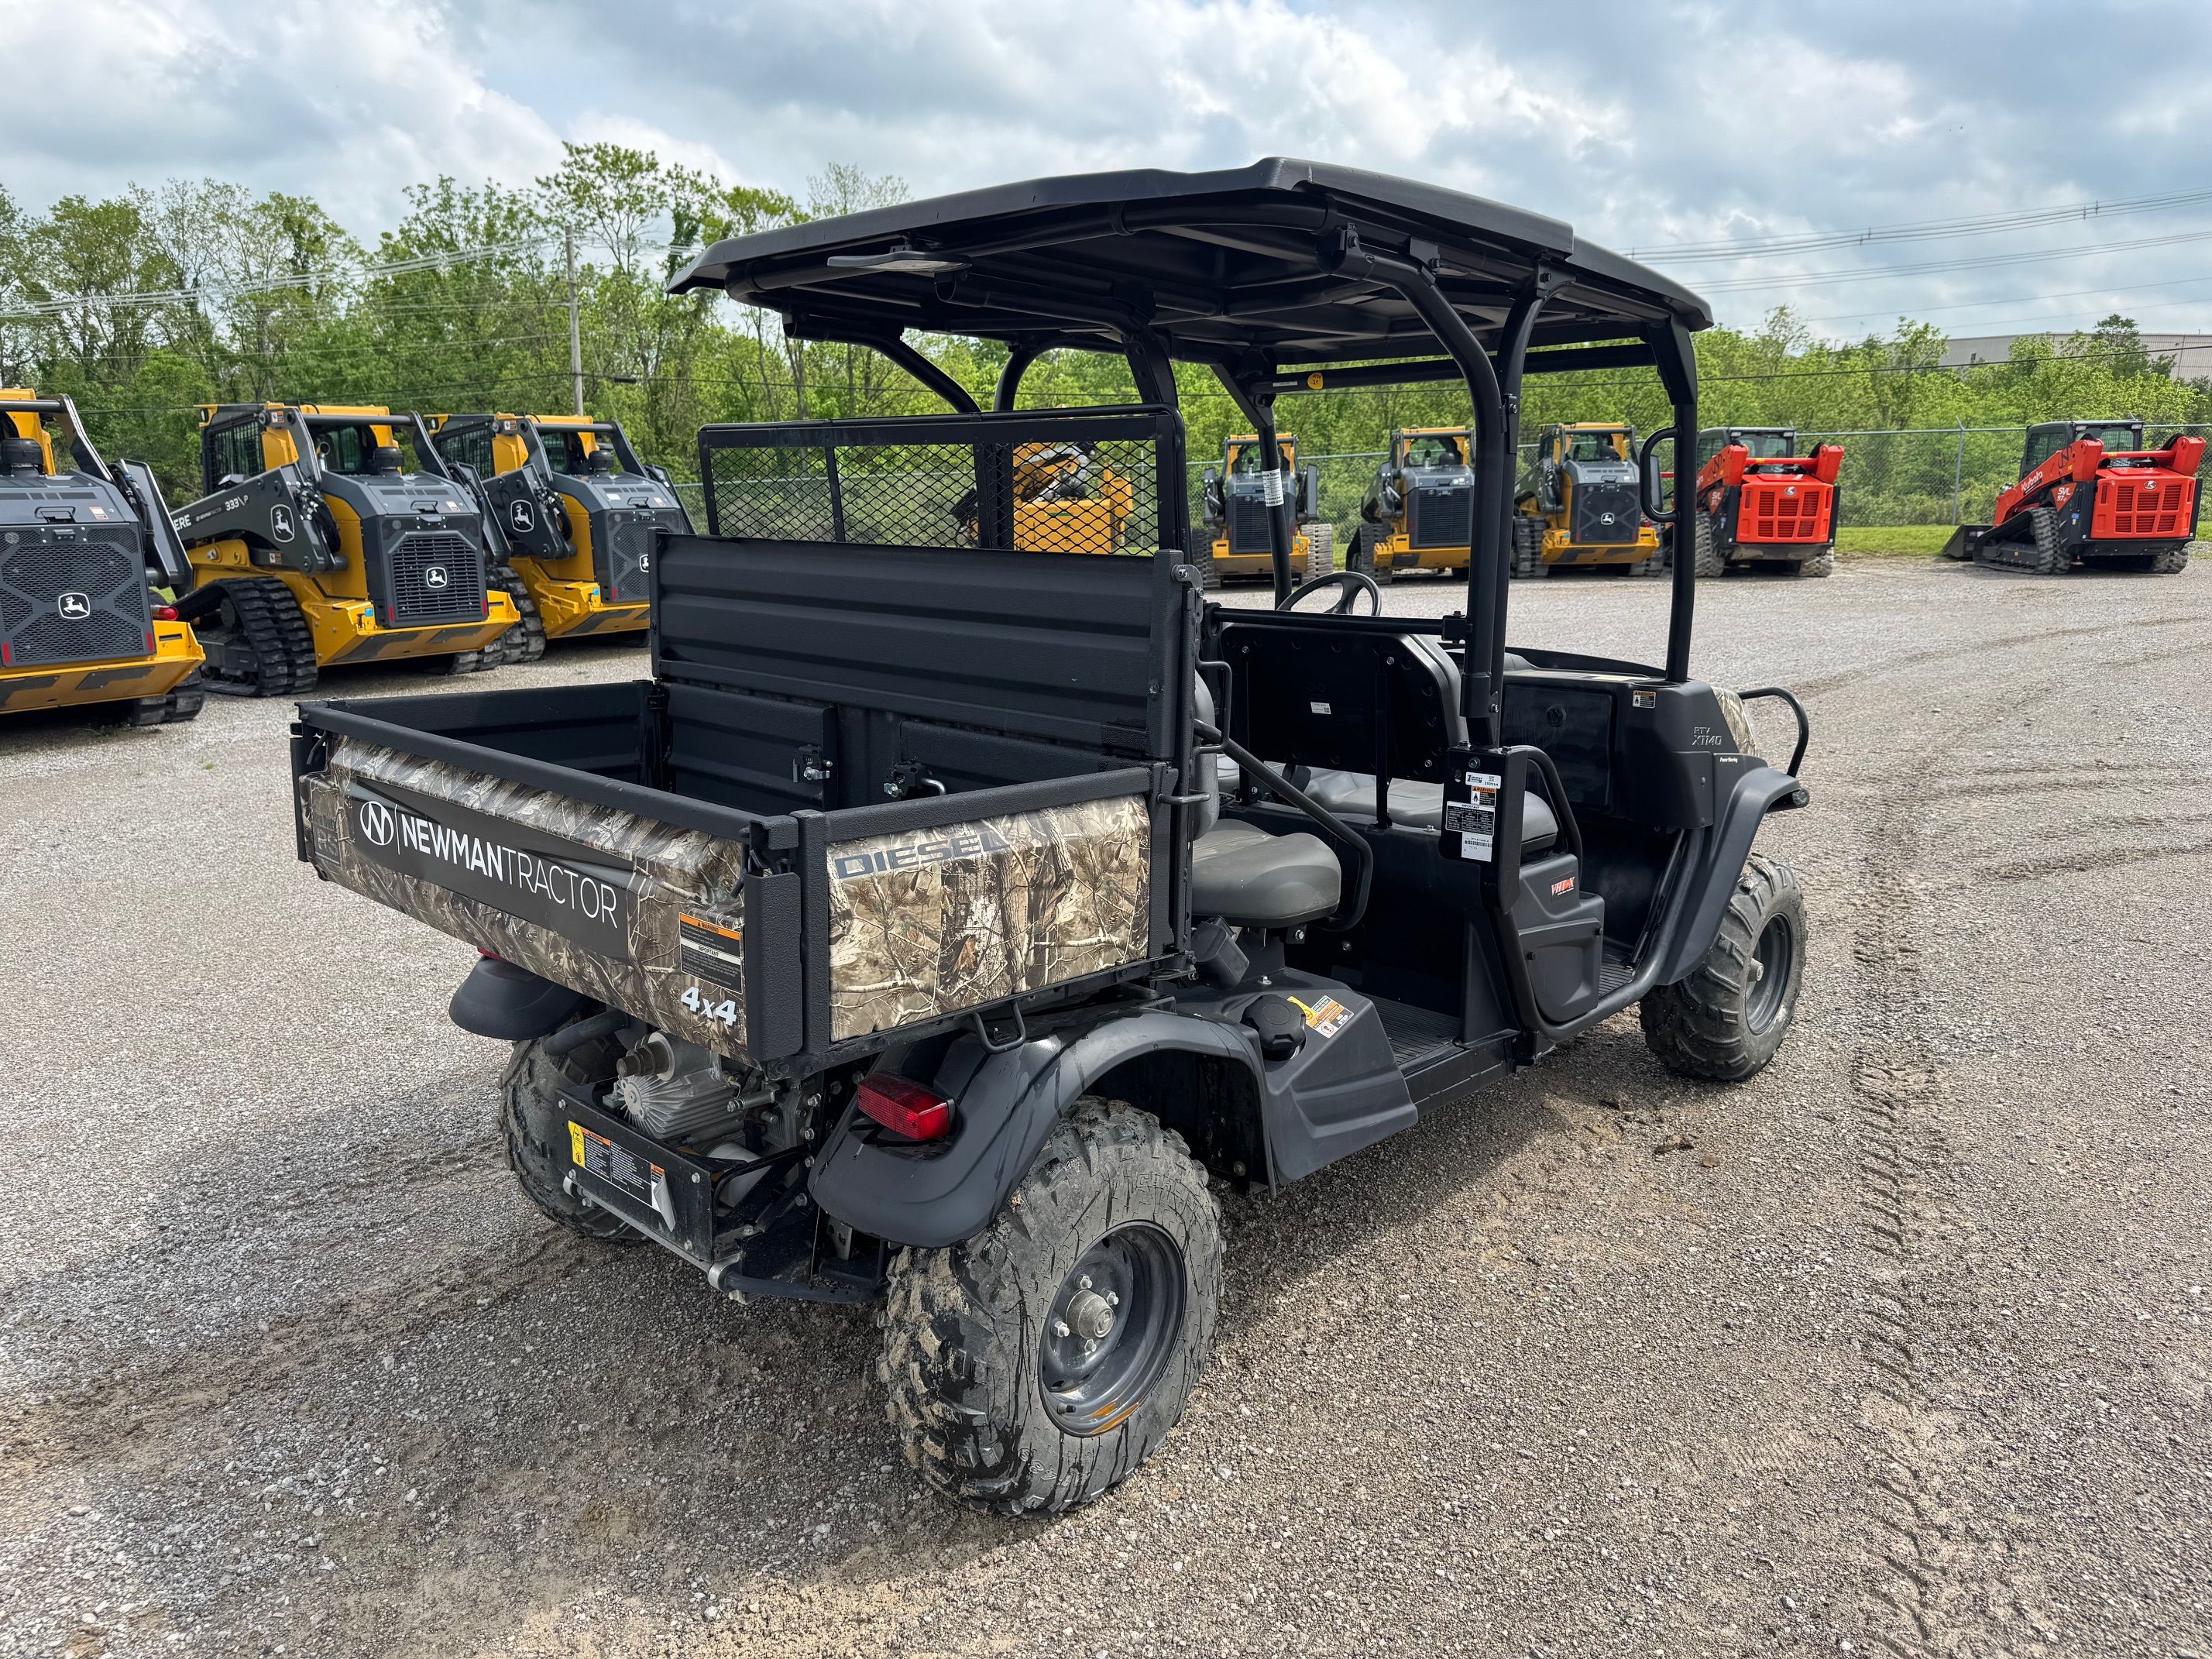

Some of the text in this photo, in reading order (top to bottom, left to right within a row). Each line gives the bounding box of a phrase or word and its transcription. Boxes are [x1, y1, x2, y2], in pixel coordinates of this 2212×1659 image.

[2021, 471, 2043, 491] Kubota
[2057, 487, 2071, 496] SVL
[1692, 735, 1722, 746] X1140
[834, 832, 1011, 879] DIESEL
[701, 922, 720, 934] WARNING
[698, 945, 720, 957] IMPORTANT
[680, 985, 737, 1027] 4x4
